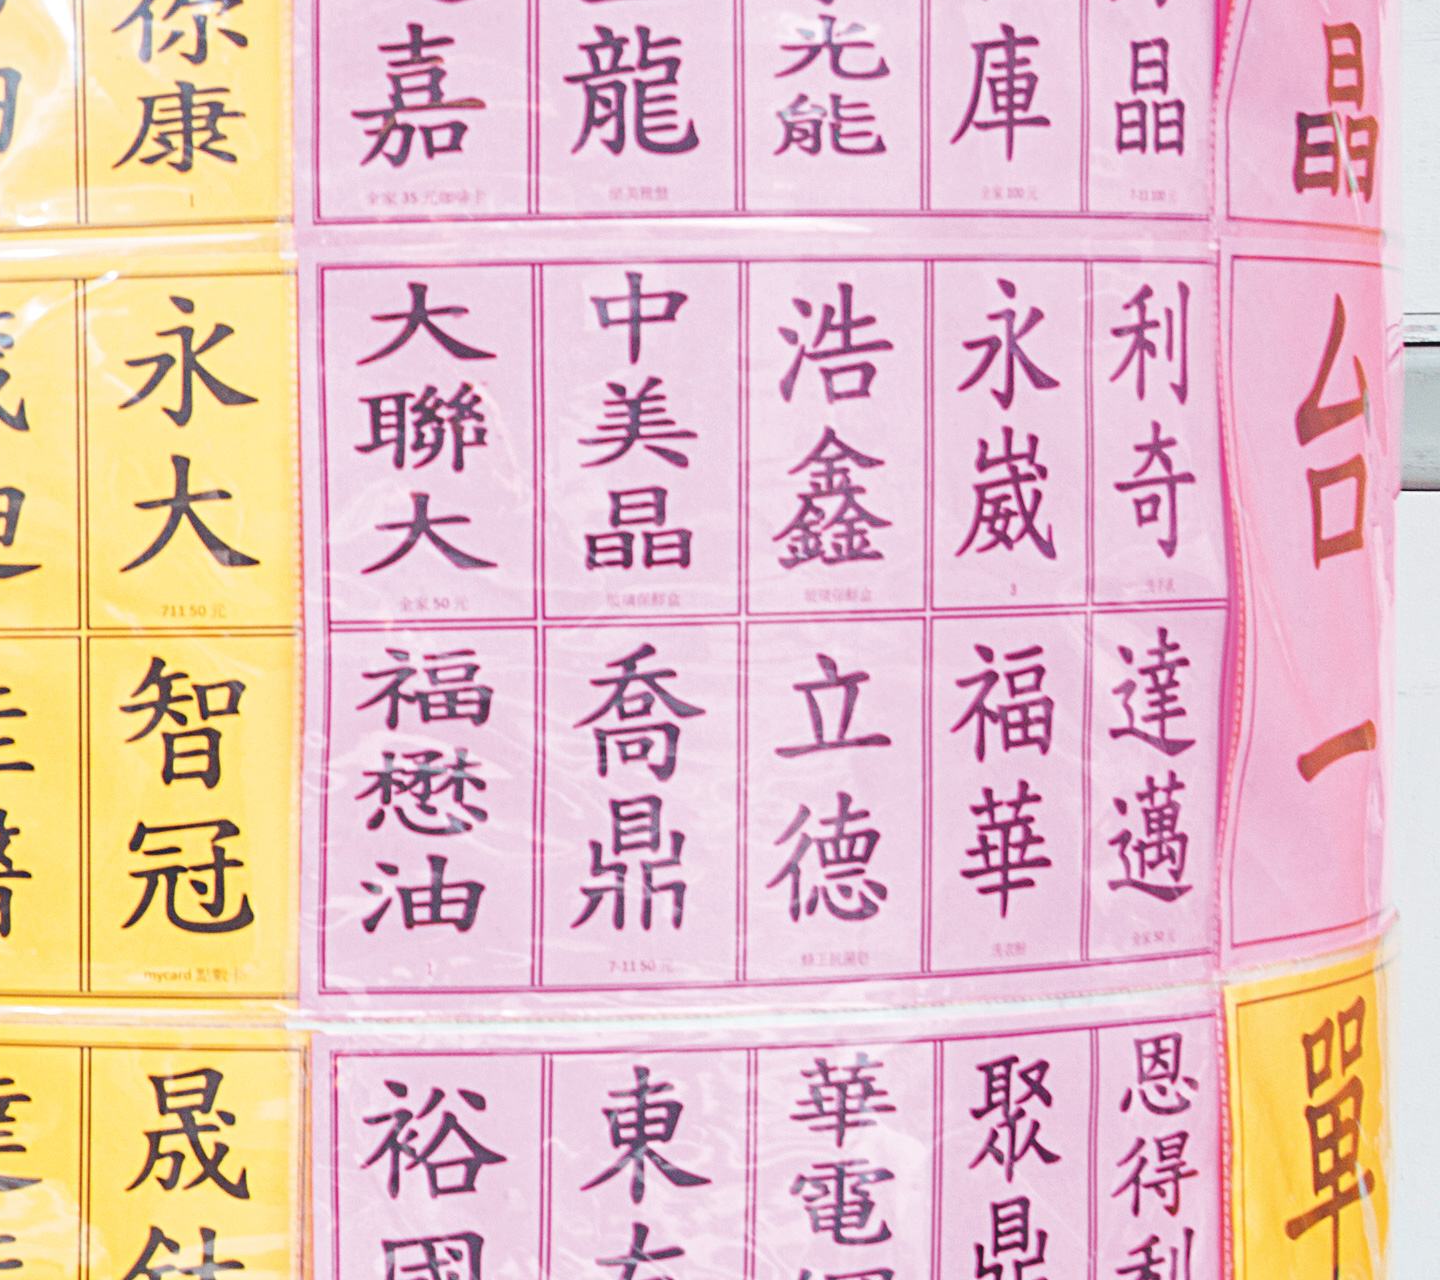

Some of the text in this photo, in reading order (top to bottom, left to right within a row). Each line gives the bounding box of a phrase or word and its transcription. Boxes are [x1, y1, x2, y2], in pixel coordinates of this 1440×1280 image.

[118, 296, 261, 574] 永大
[354, 280, 499, 576] 大聯大
[578, 271, 699, 571] 中美晶
[771, 283, 894, 570] 浩鑫
[953, 277, 1060, 563] 永崴
[1109, 278, 1197, 560] 利奇
[1294, 294, 1377, 784] 台一
[119, 656, 255, 935] 智冠
[354, 646, 493, 934] 福懋油
[572, 641, 706, 932] 喬鼎
[766, 653, 892, 924] 立德
[950, 642, 1056, 919] 福華
[1106, 627, 1197, 904] 達邁
